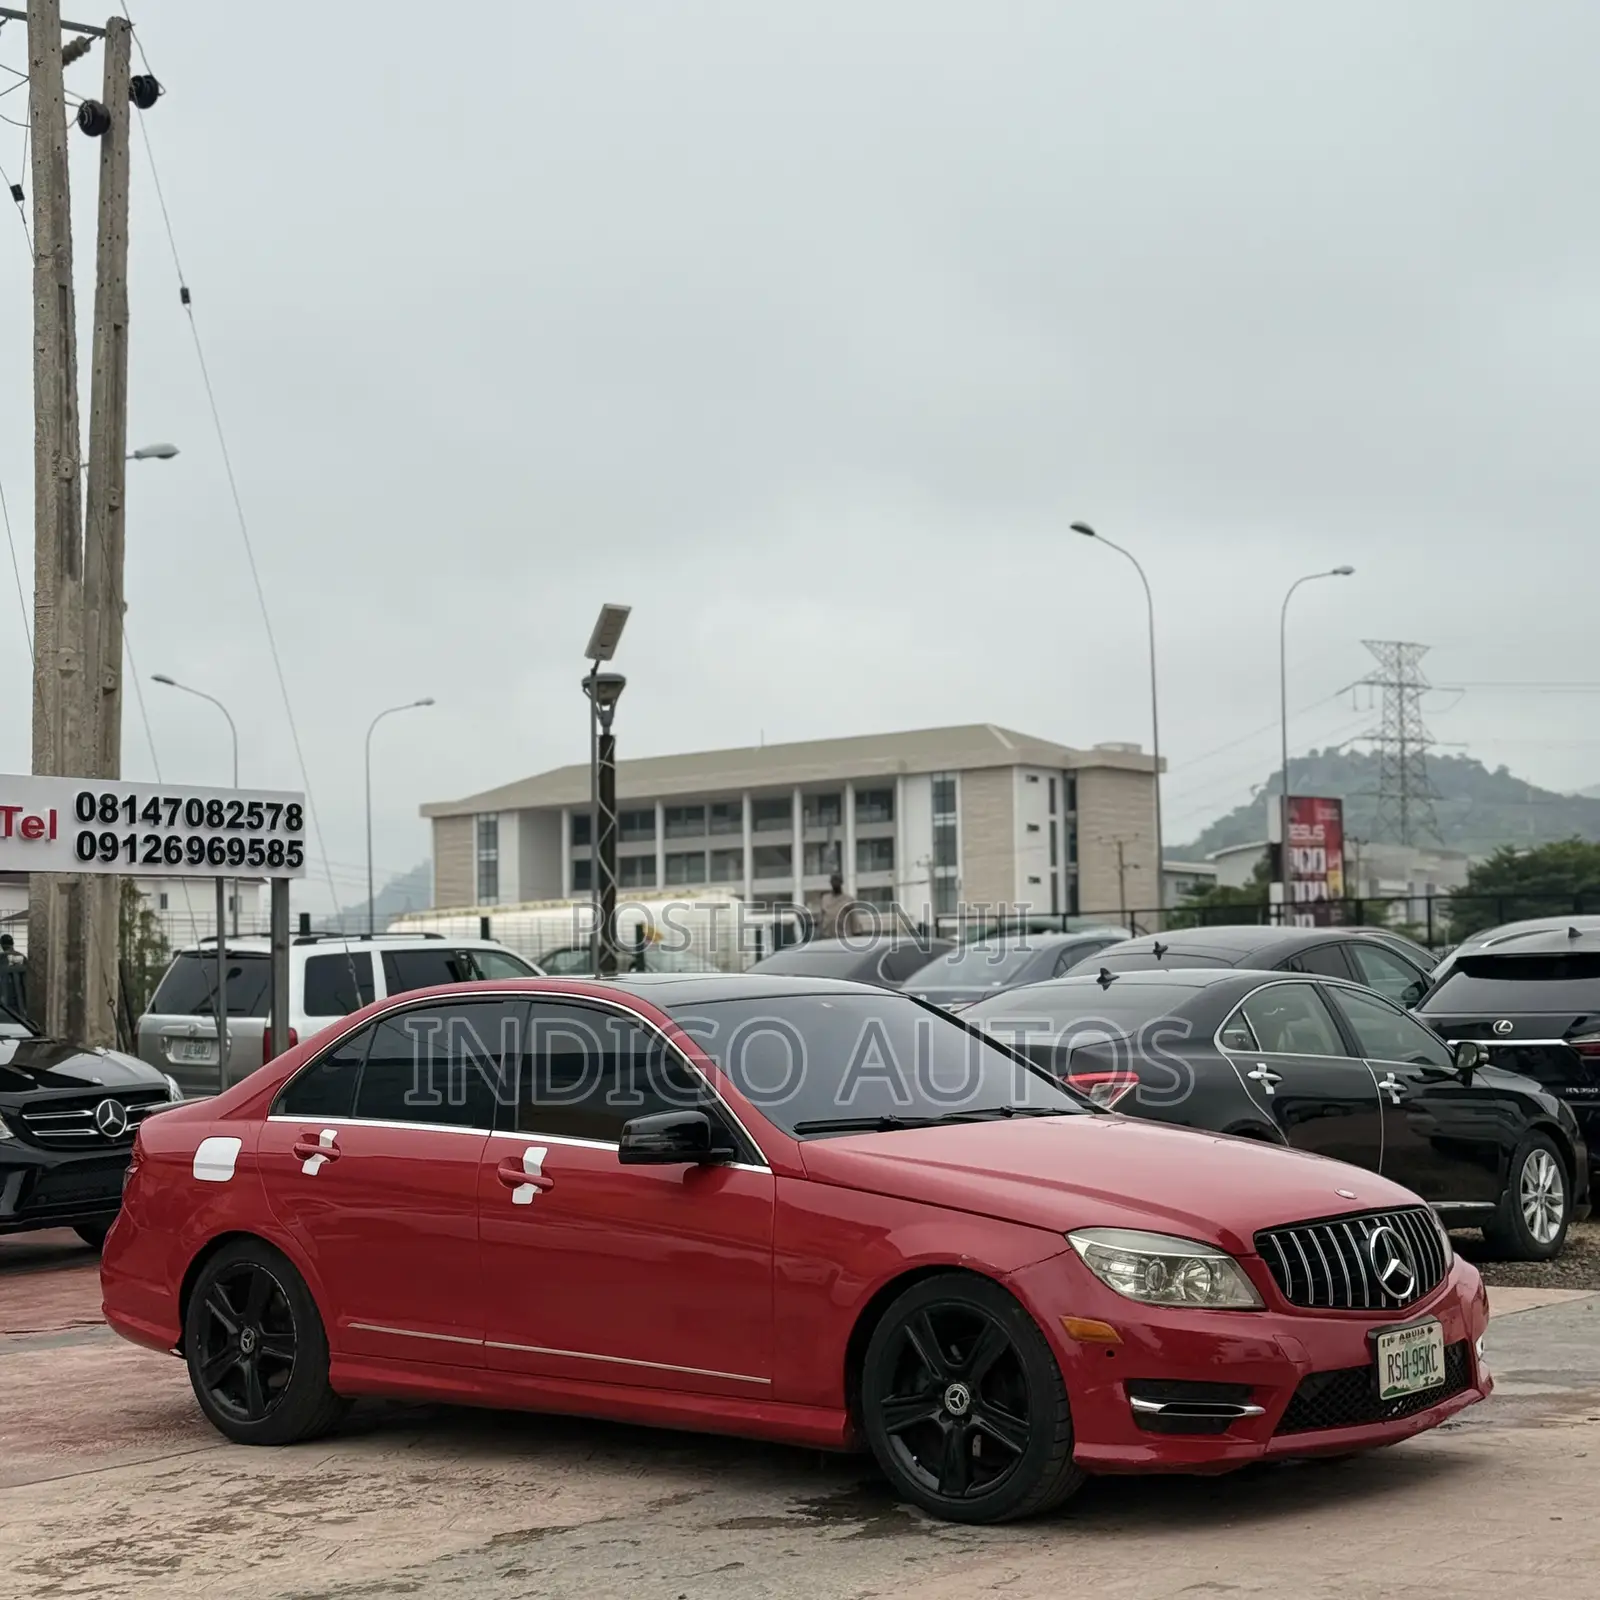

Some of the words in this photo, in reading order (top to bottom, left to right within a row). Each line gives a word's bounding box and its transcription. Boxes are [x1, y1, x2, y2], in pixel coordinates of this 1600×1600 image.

[0, 805, 58, 841] Tel
[75, 791, 304, 832] 08147082578
[76, 830, 304, 868] 09126969585
